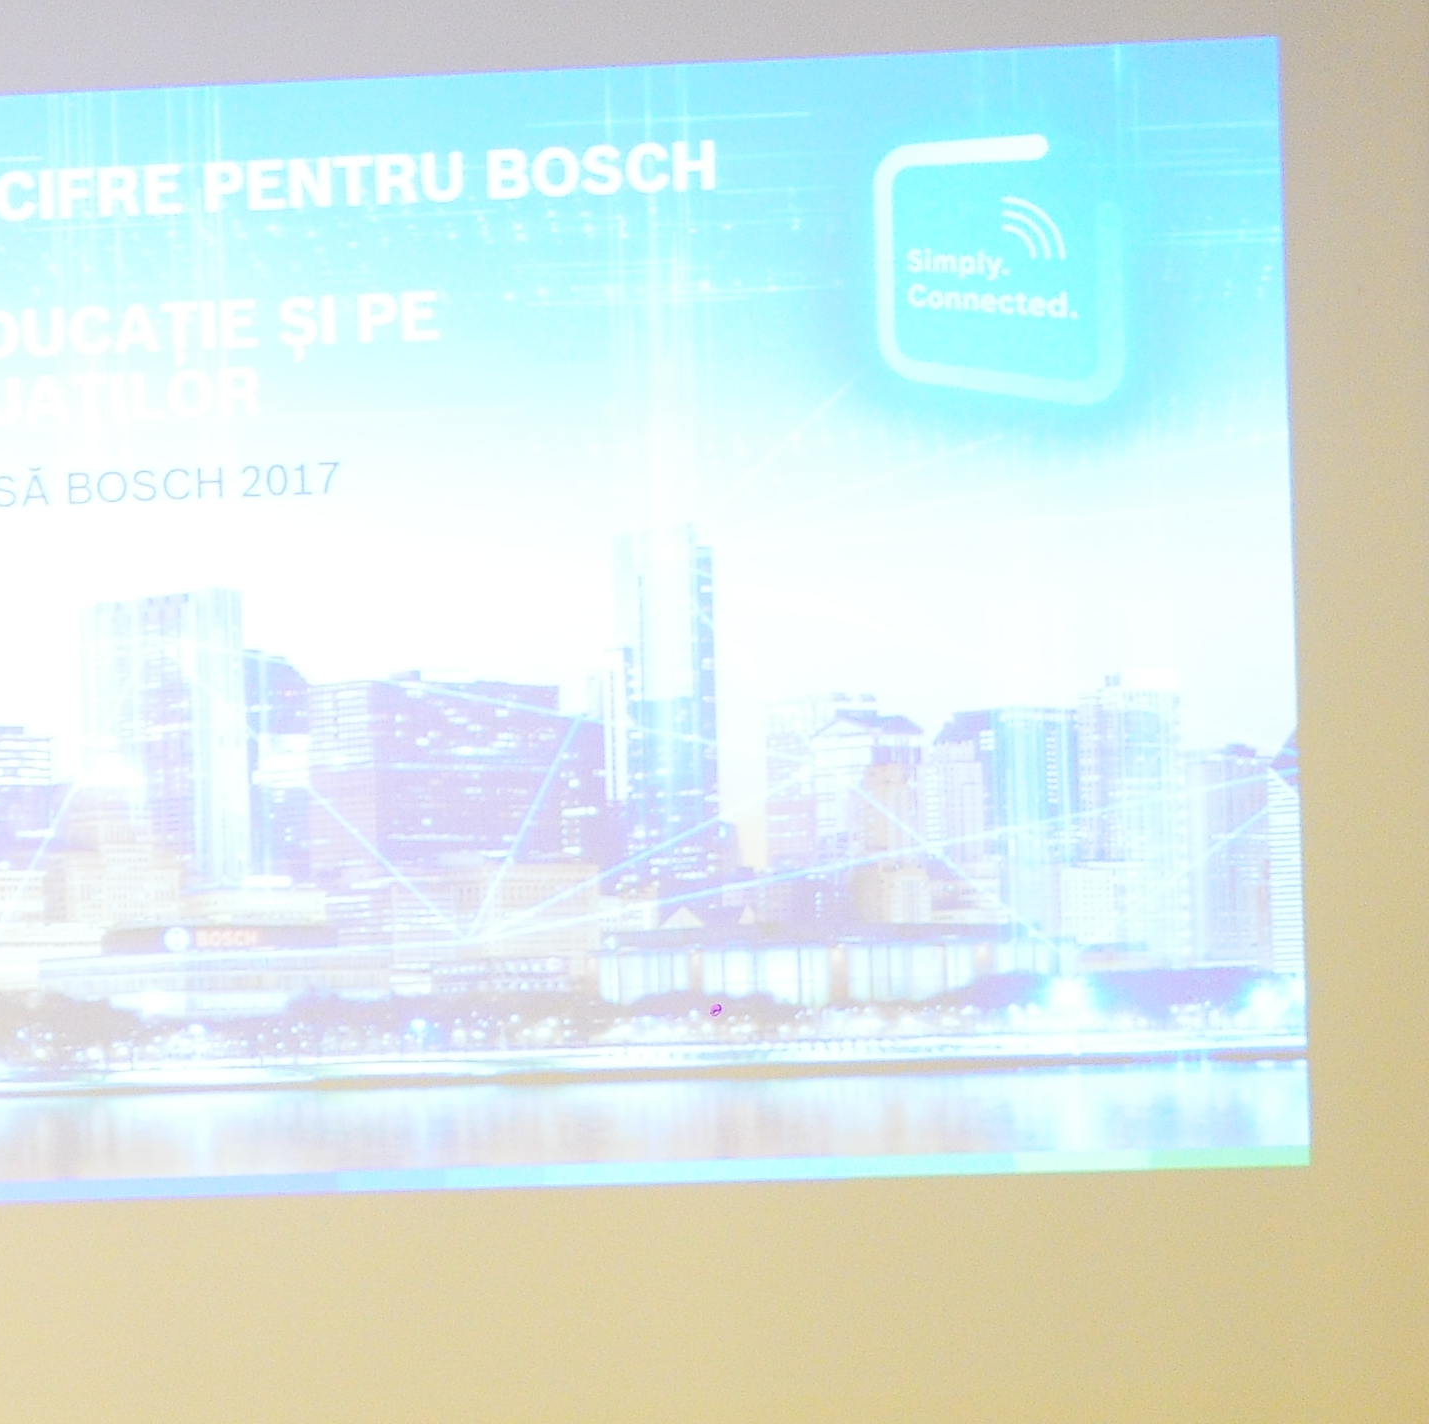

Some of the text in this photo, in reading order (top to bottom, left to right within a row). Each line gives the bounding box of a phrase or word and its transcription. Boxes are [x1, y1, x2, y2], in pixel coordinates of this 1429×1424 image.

[204, 149, 464, 212] PENTRU
[486, 138, 718, 201] BOSCH
[907, 248, 1011, 281] Simply.
[357, 289, 442, 344] PE
[907, 284, 1079, 320] Connected.
[67, 465, 225, 506] BOSCH
[240, 461, 342, 498] 2017
[196, 929, 259, 947] BOSCH
